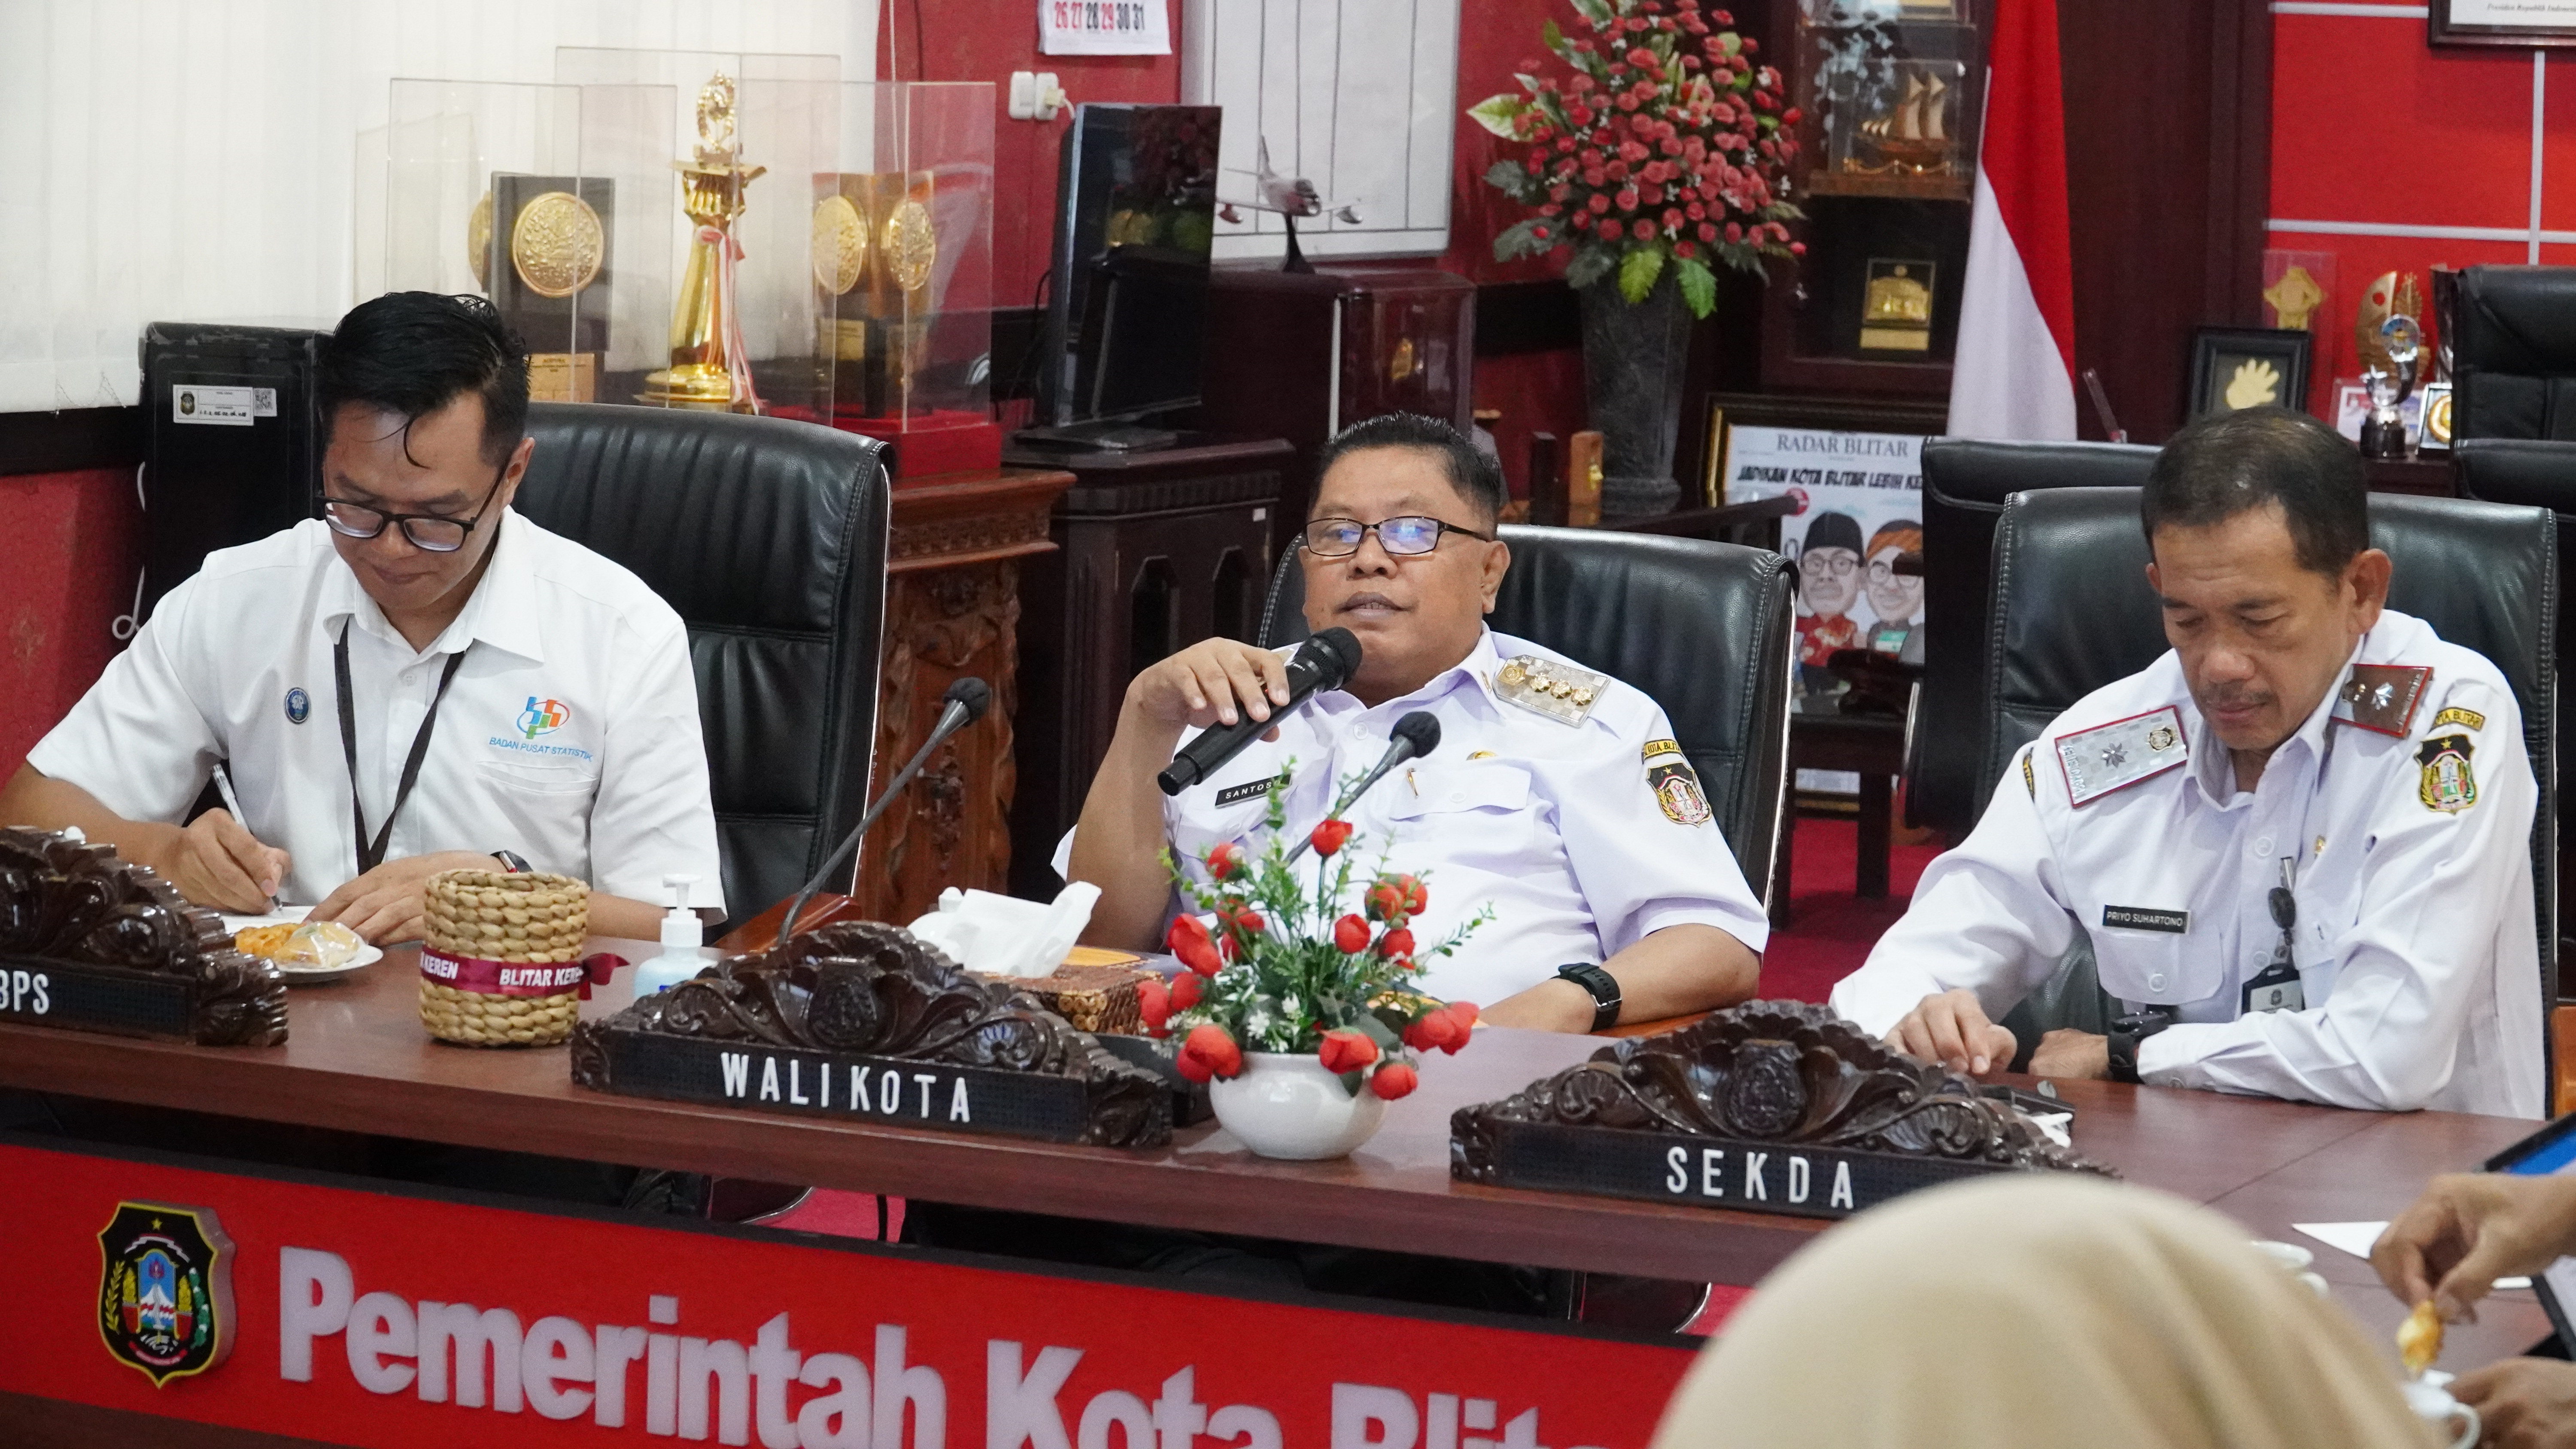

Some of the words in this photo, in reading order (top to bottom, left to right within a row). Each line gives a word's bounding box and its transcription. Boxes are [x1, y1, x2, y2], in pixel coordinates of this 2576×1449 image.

[1054, 2, 1068, 28] 26
[1071, 2, 1082, 28] 27
[1085, 2, 1099, 29] 28
[1101, 3, 1114, 30] 29
[1117, 3, 1130, 30] 30
[1132, 3, 1145, 30] 31
[1777, 434, 1838, 452] RADAR
[1845, 437, 1908, 457] BLITAR
[1790, 468, 1822, 485] KOTA
[1825, 470, 1866, 486] BLITAR
[489, 737, 519, 749] BADAN
[520, 743, 550, 753] PUSAT
[551, 746, 593, 762] STATISTIK
[2107, 911, 2131, 922] PRIYO
[2132, 913, 2183, 927] SUHARTONO
[499, 968, 553, 987] BLITAR
[1667, 1146, 1854, 1210] SEKDA
[280, 1246, 947, 1449] Pemerintah
